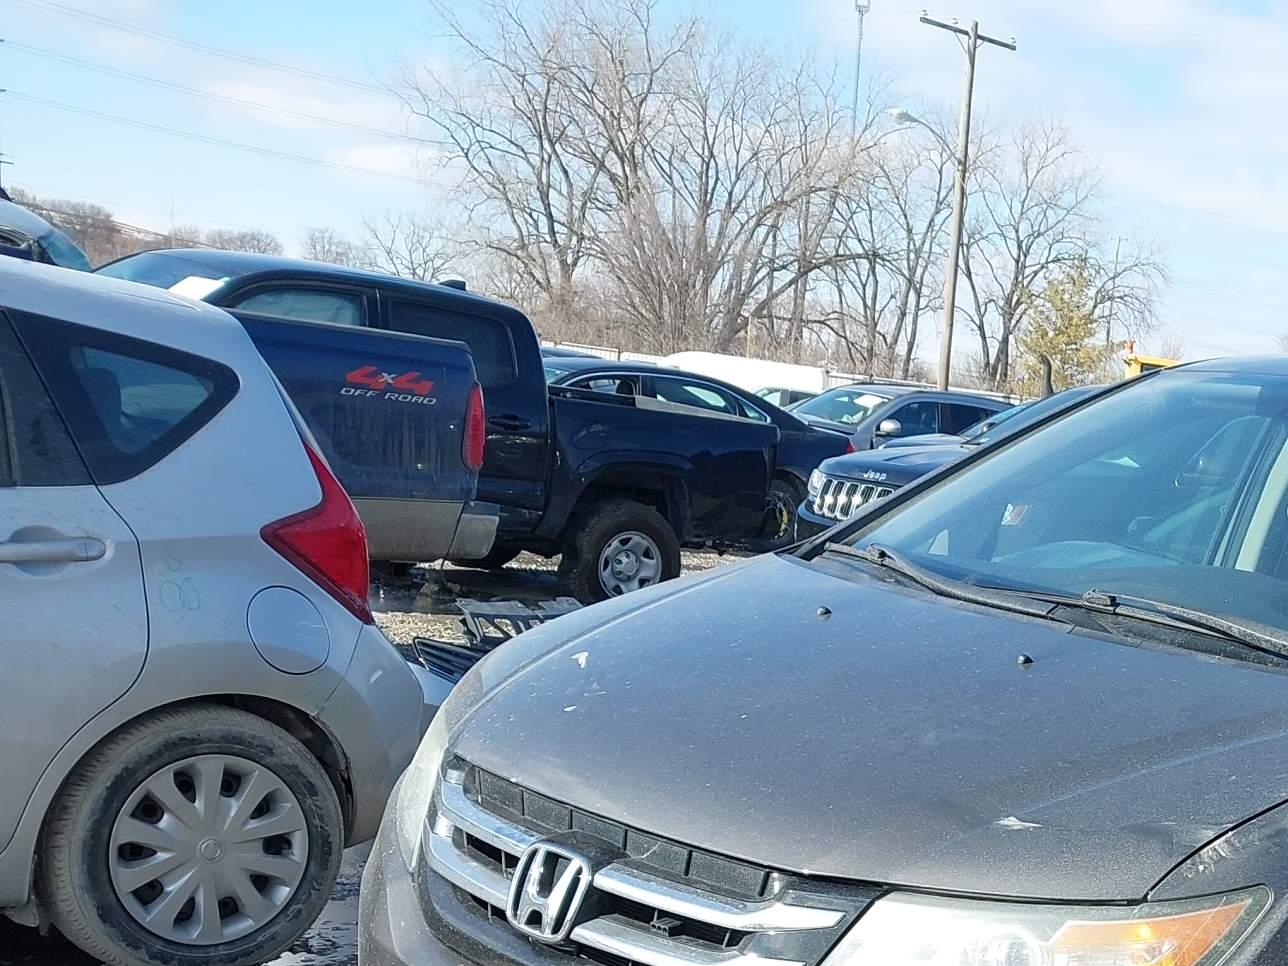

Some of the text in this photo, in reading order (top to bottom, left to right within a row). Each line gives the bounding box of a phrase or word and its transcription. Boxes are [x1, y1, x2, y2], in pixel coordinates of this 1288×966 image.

[340, 387, 437, 405] OFF ROAD
[863, 469, 887, 481] Jeep
